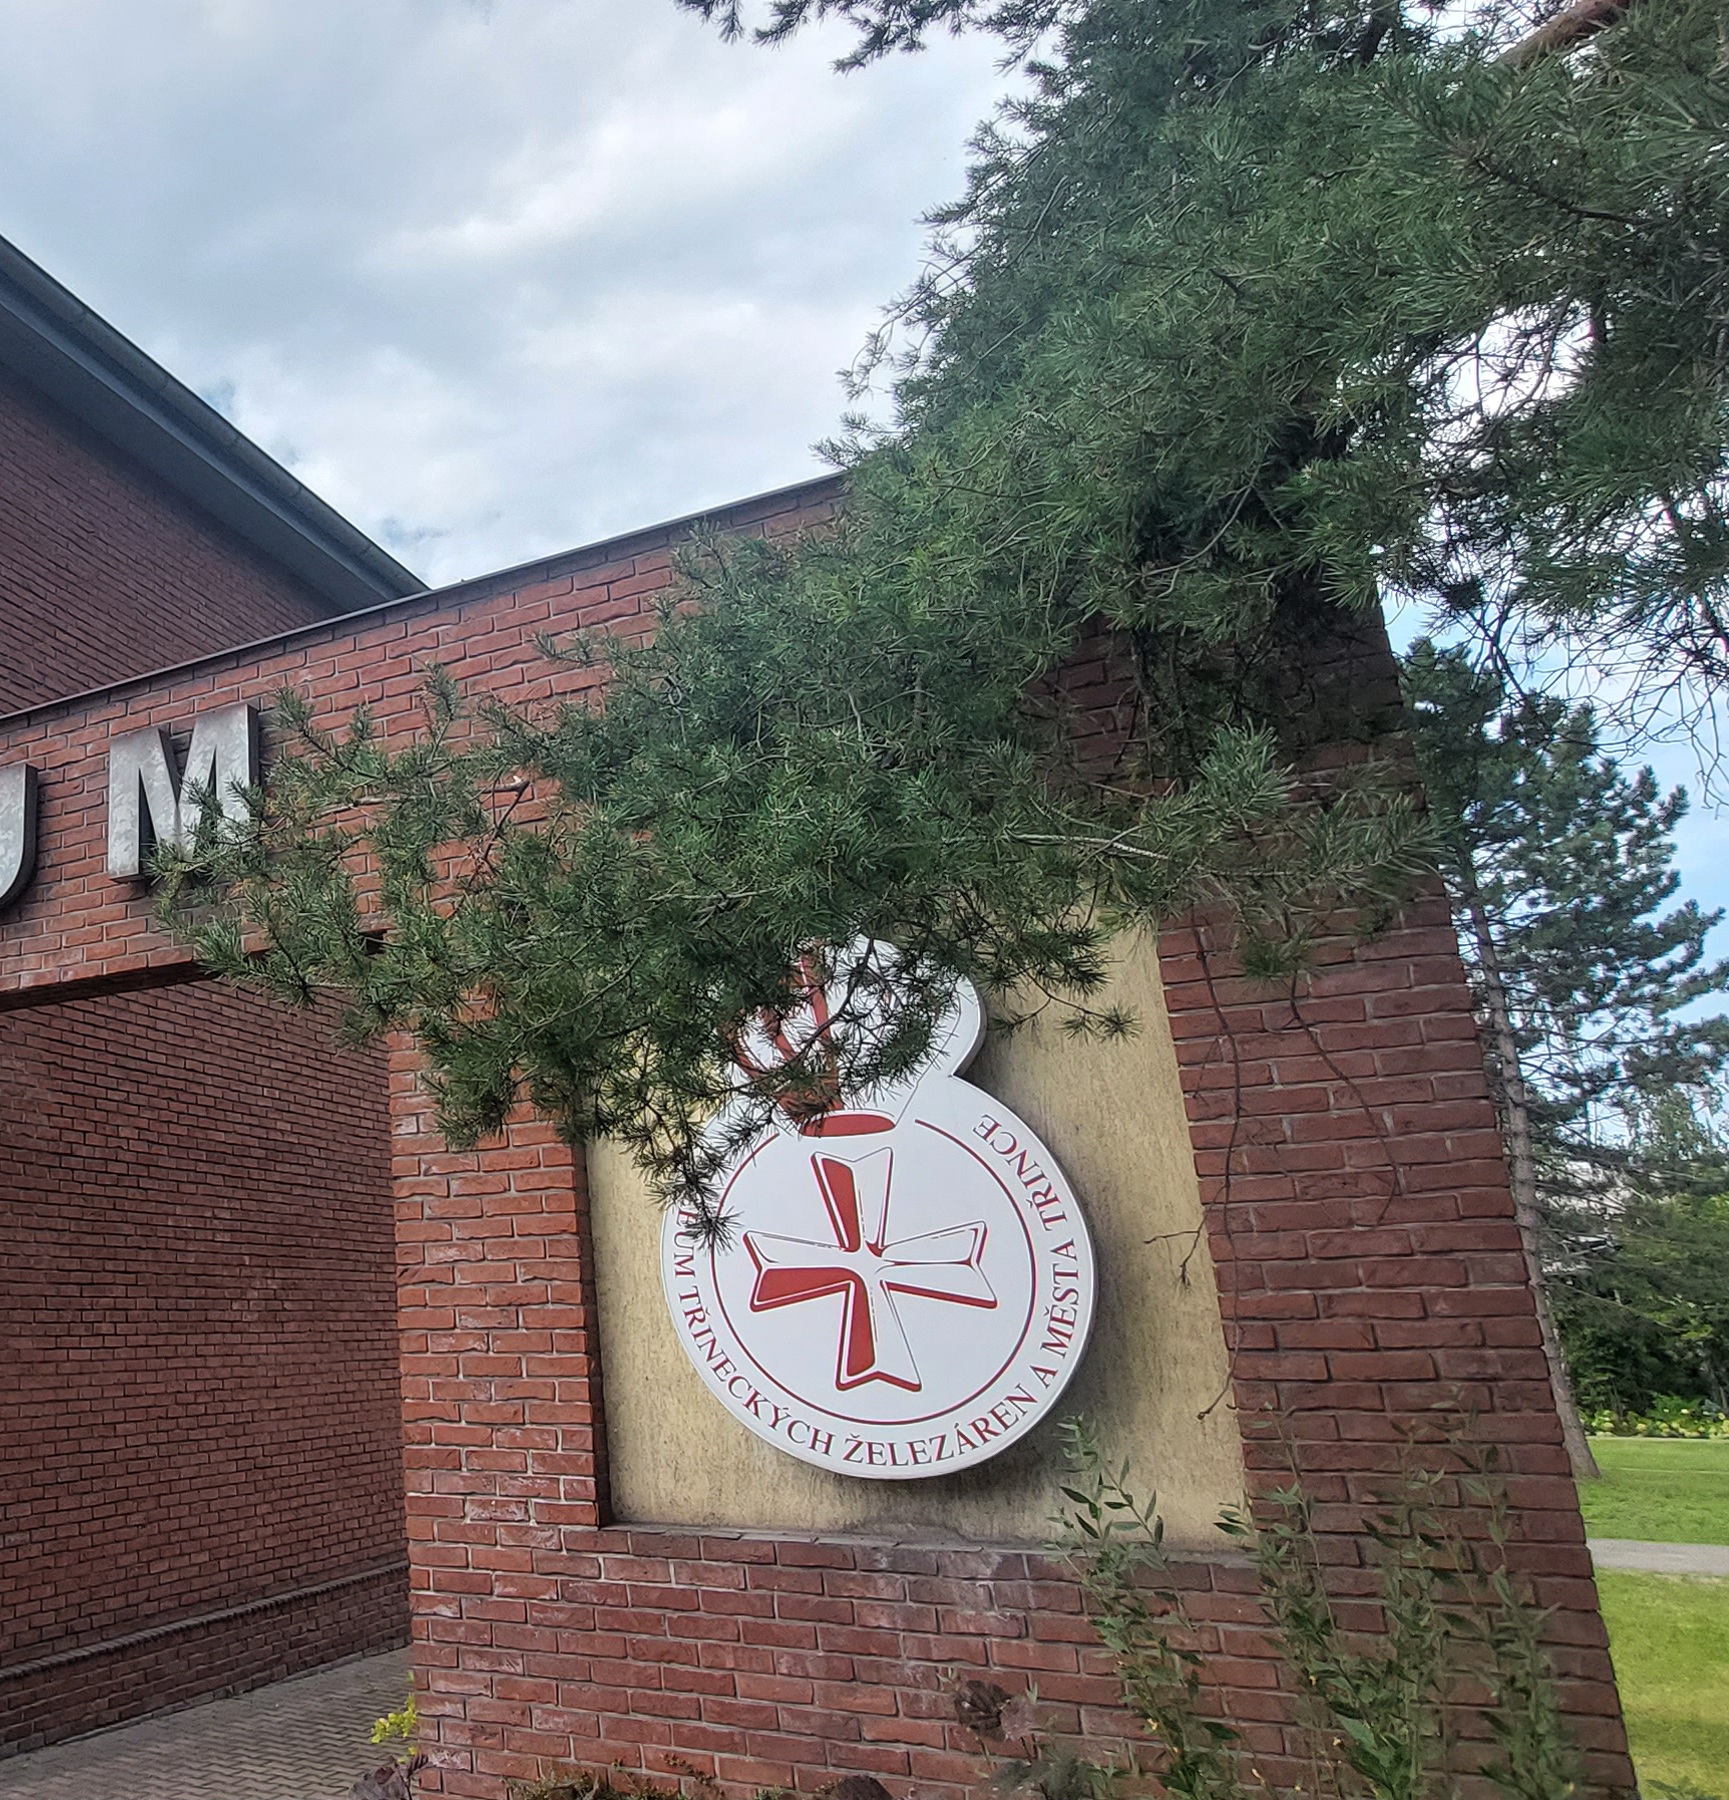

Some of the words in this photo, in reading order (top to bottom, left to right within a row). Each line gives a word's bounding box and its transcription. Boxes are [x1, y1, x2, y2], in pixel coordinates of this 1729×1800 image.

[972, 1114, 1068, 1231] TŘINCE
[1040, 1238, 1079, 1358] MĚSTA
[678, 1285, 836, 1456] TŘINECKÝCH
[843, 1383, 1038, 1466] ŽELEZÁREN
[1030, 1364, 1059, 1389] A
